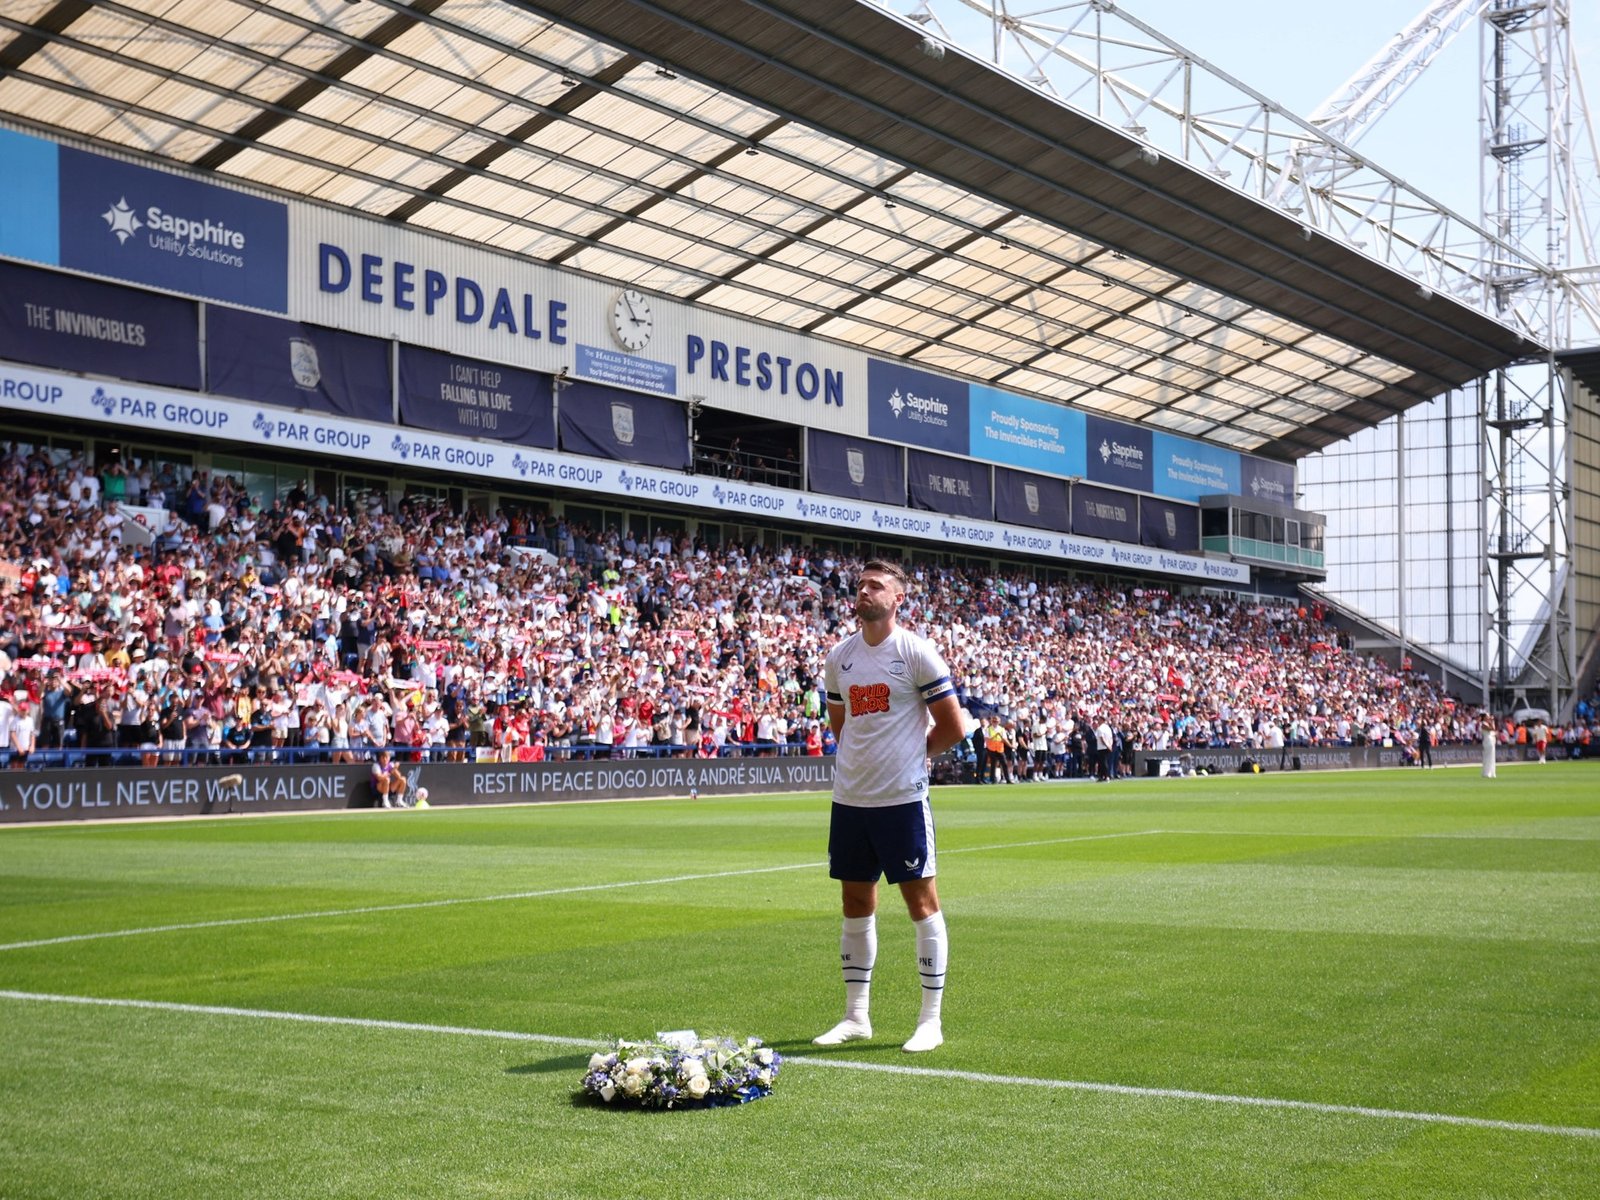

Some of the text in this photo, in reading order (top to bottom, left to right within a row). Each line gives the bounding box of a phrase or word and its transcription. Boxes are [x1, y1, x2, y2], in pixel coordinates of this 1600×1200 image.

[147, 206, 245, 249] Sapphire
[149, 234, 243, 268] Utility Solutions
[319, 243, 567, 345] DEEPDALE
[24, 303, 146, 347] THE INVINCIBLES
[455, 364, 479, 385] CAN'T
[480, 369, 501, 388] HELP
[687, 334, 843, 407] PRESTON
[441, 383, 513, 412] FALLING IN LOVE
[906, 391, 949, 416] Sapphire
[120, 397, 229, 429] PAR GROUP
[458, 408, 498, 430] WITH YOU
[907, 410, 948, 428] Utility Solutions
[991, 411, 1060, 439] Proudly Sponsoring
[278, 421, 371, 450] PAR GROUP
[985, 426, 1066, 454] The Invincibles Pavilion
[413, 442, 494, 468] PAR GROUP
[1111, 441, 1143, 460] Sapphire
[531, 460, 603, 484] PAR GROUP
[635, 476, 699, 499] PAR GROUP
[727, 490, 785, 511] PAR GROUP
[810, 504, 861, 522] PAR GROUP
[884, 516, 931, 533] PAR GROUP
[951, 525, 994, 543] PAR GROUP
[1012, 535, 1052, 550] PAR GROUP
[1068, 544, 1105, 558] PAR GROUP
[1120, 551, 1153, 565] PAR GROUP
[1166, 557, 1198, 572] PAR GROUP
[1210, 564, 1239, 578] PAR GROUP
[849, 683, 890, 700] SPUD
[851, 697, 890, 717] BROS
[473, 772, 517, 795] REST
[520, 772, 537, 792] IN
[541, 771, 594, 792] PEACE
[597, 769, 647, 790] DIOGO
[649, 768, 684, 788] JOTA
[686, 768, 697, 787] &
[698, 762, 745, 786] ANDRÉ
[748, 766, 785, 785] SILVA.
[787, 765, 829, 783] YOU'LL
[16, 782, 110, 810] YOU'LL
[117, 779, 199, 806] NEVER
[273, 775, 346, 800] ALONE
